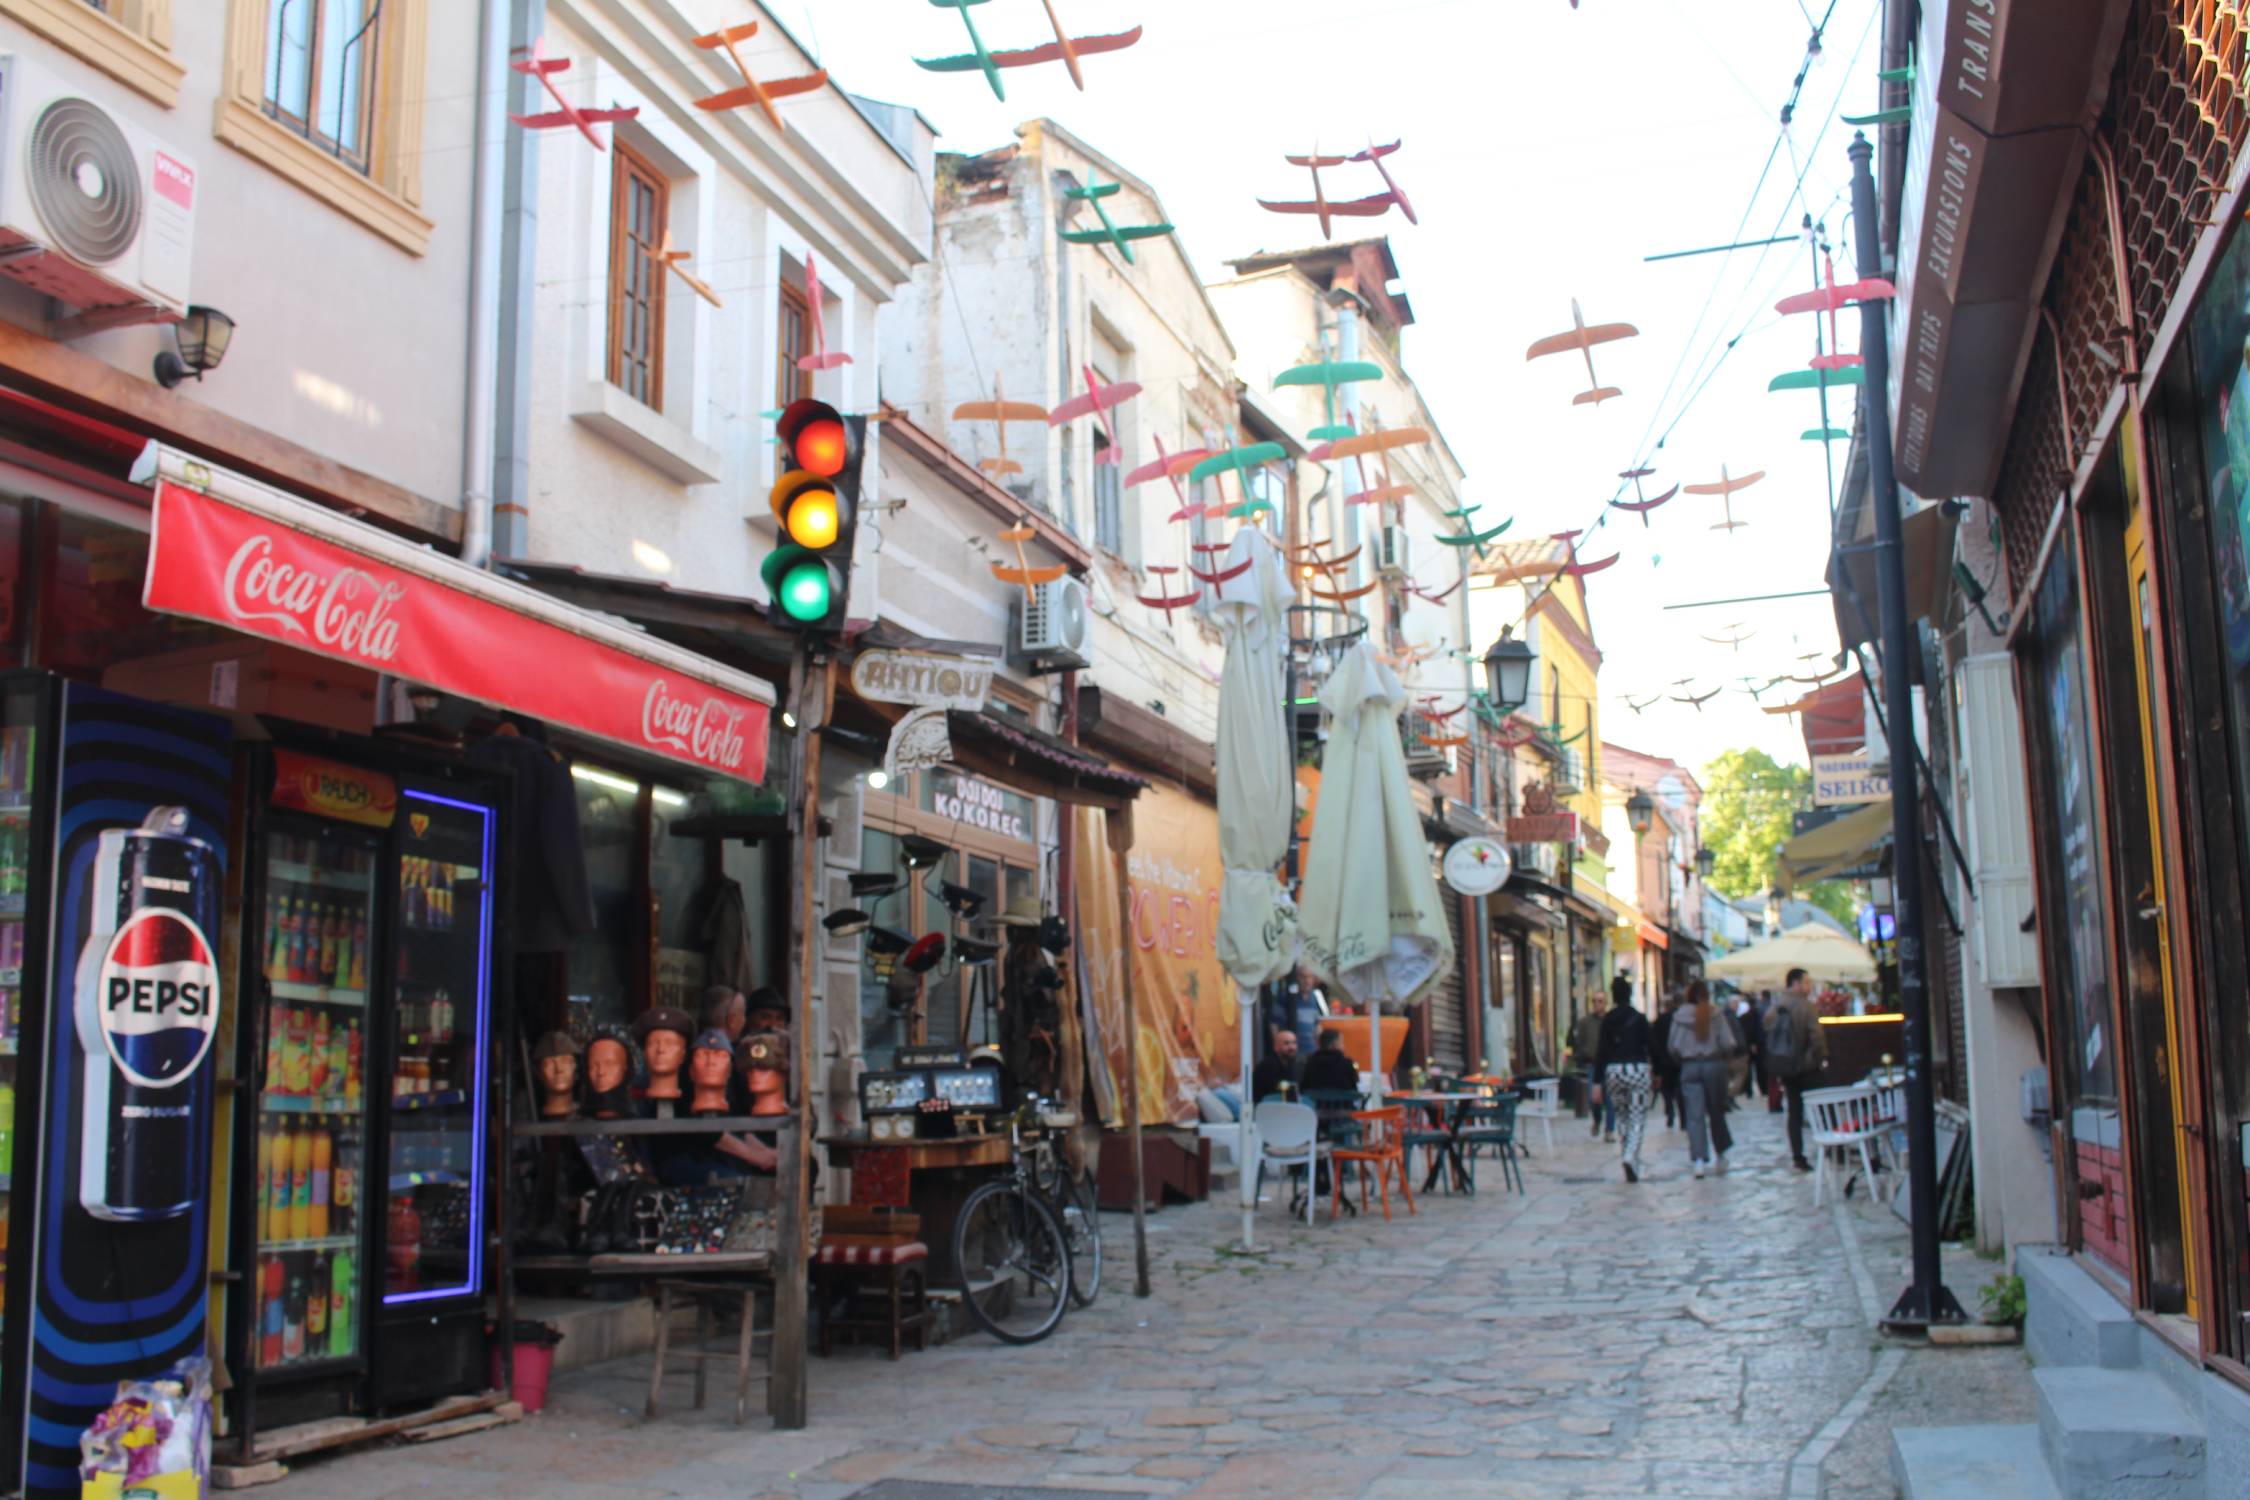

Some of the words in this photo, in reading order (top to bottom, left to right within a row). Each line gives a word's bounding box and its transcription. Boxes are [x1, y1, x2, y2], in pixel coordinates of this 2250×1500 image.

[1928, 136, 1972, 279] EXCURSIONS
[1918, 310, 1942, 361] TRIPS
[224, 535, 408, 660] Coca-Cola
[642, 678, 745, 768] Coca-Cola
[1818, 777, 1894, 798] SEIKO
[935, 792, 1022, 837] KOKOREC
[108, 977, 210, 1016] PEPSI
